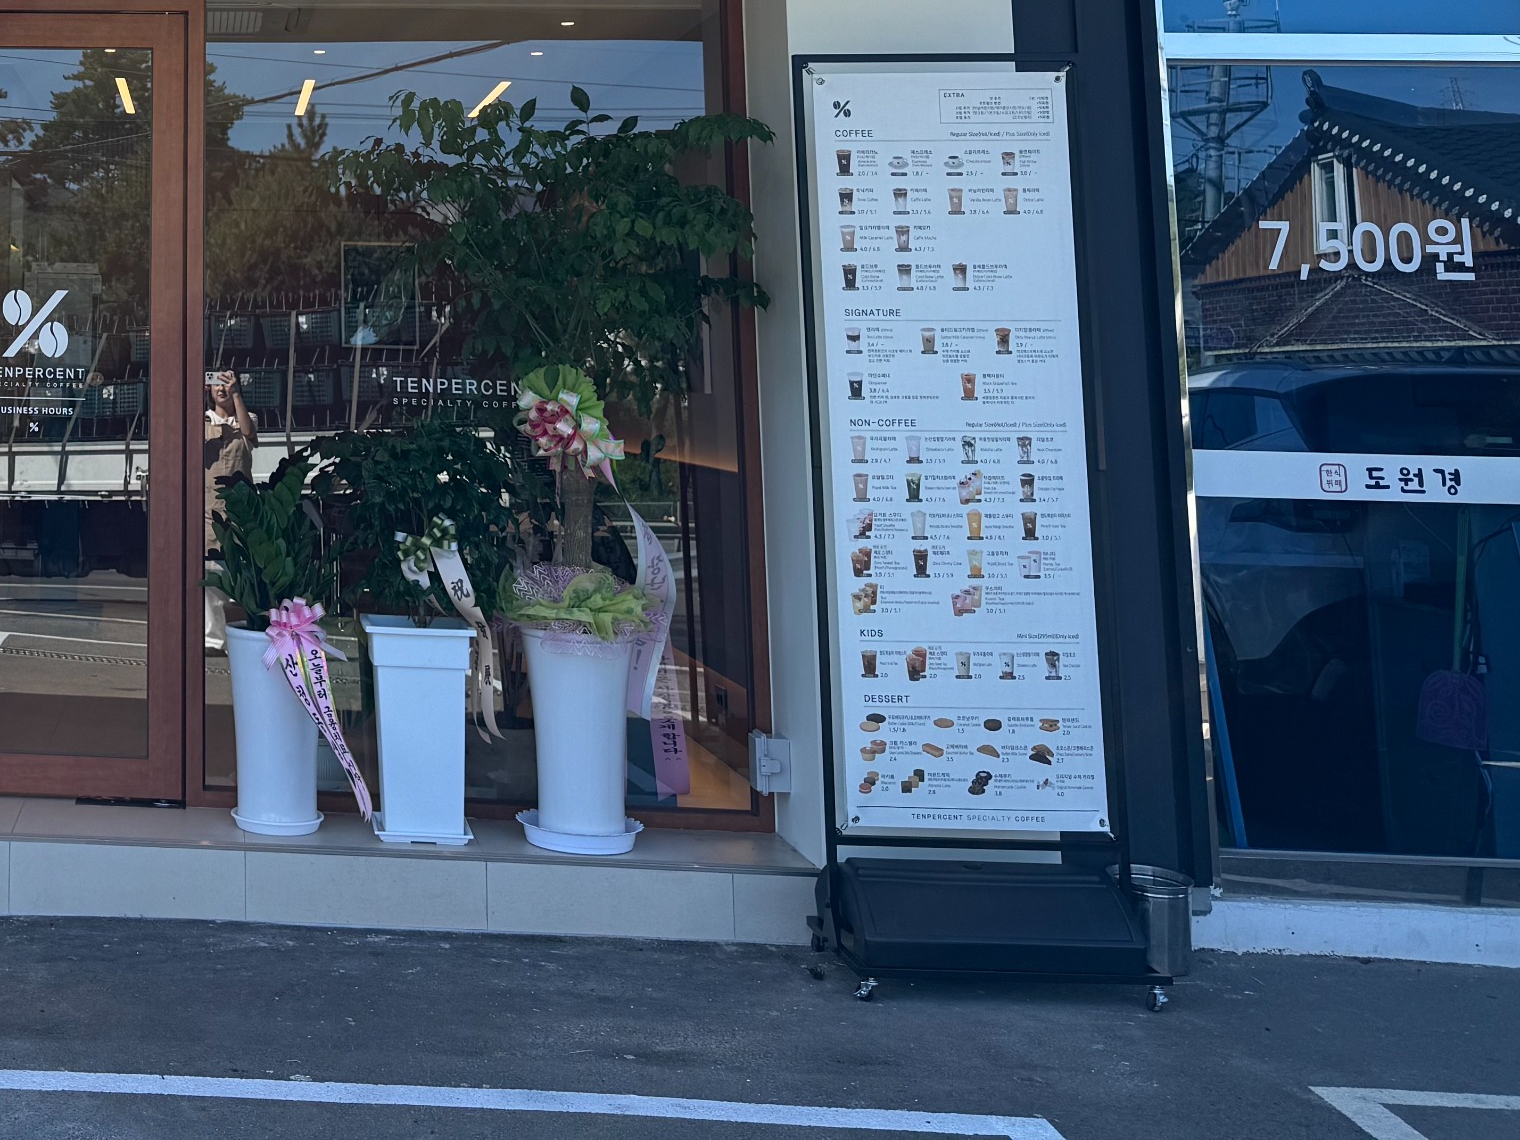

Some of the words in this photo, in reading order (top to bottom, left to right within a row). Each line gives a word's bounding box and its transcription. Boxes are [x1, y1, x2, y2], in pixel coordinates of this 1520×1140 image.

[835, 129, 873, 138] COFFEE
[1259, 217, 1476, 281] 7,500원
[393, 377, 520, 395] TENPERCEN
[393, 398, 472, 407] SPECIALTY
[42, 407, 73, 415] HOURS
[850, 419, 917, 427] NON-COFFEE
[1365, 467, 1461, 495] 도원경
[860, 629, 883, 637] KIDS
[864, 695, 910, 703] DESSERT
